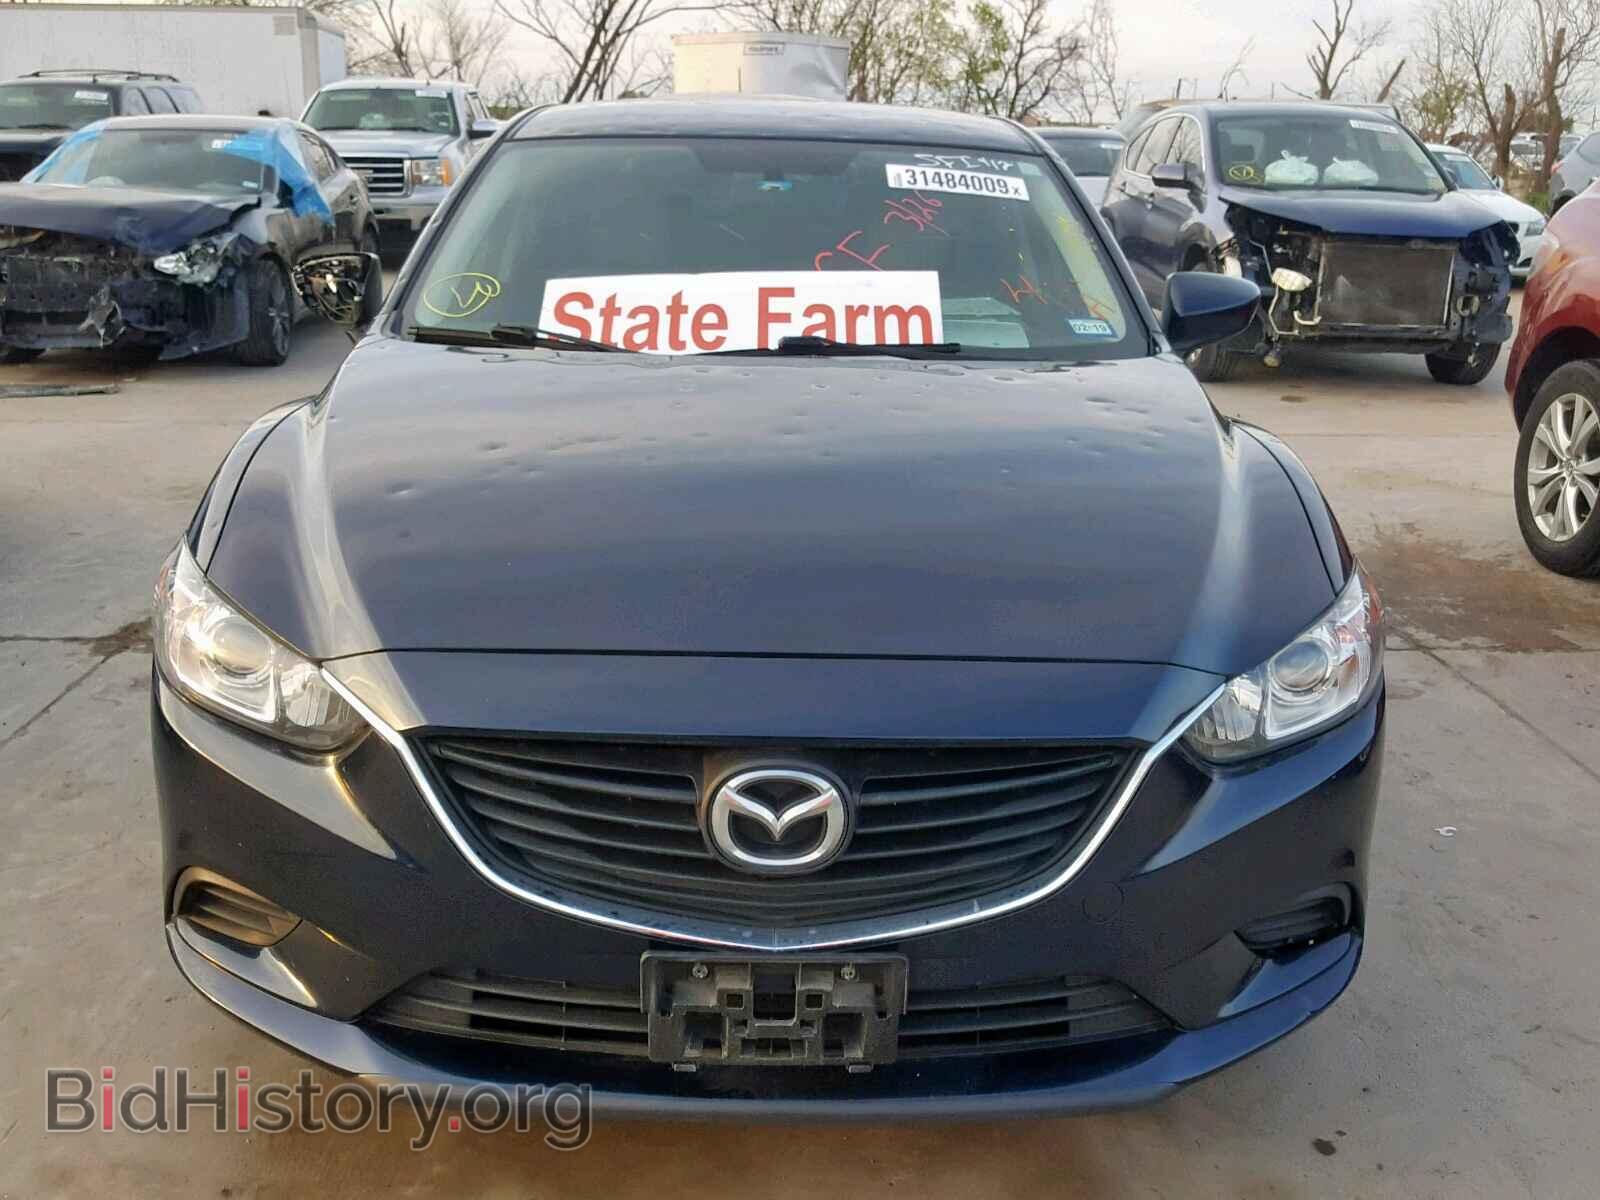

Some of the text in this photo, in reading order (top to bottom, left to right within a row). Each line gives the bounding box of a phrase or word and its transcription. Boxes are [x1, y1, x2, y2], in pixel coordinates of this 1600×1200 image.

[905, 168, 1009, 195] 31484009
[550, 286, 932, 352] State Farm
